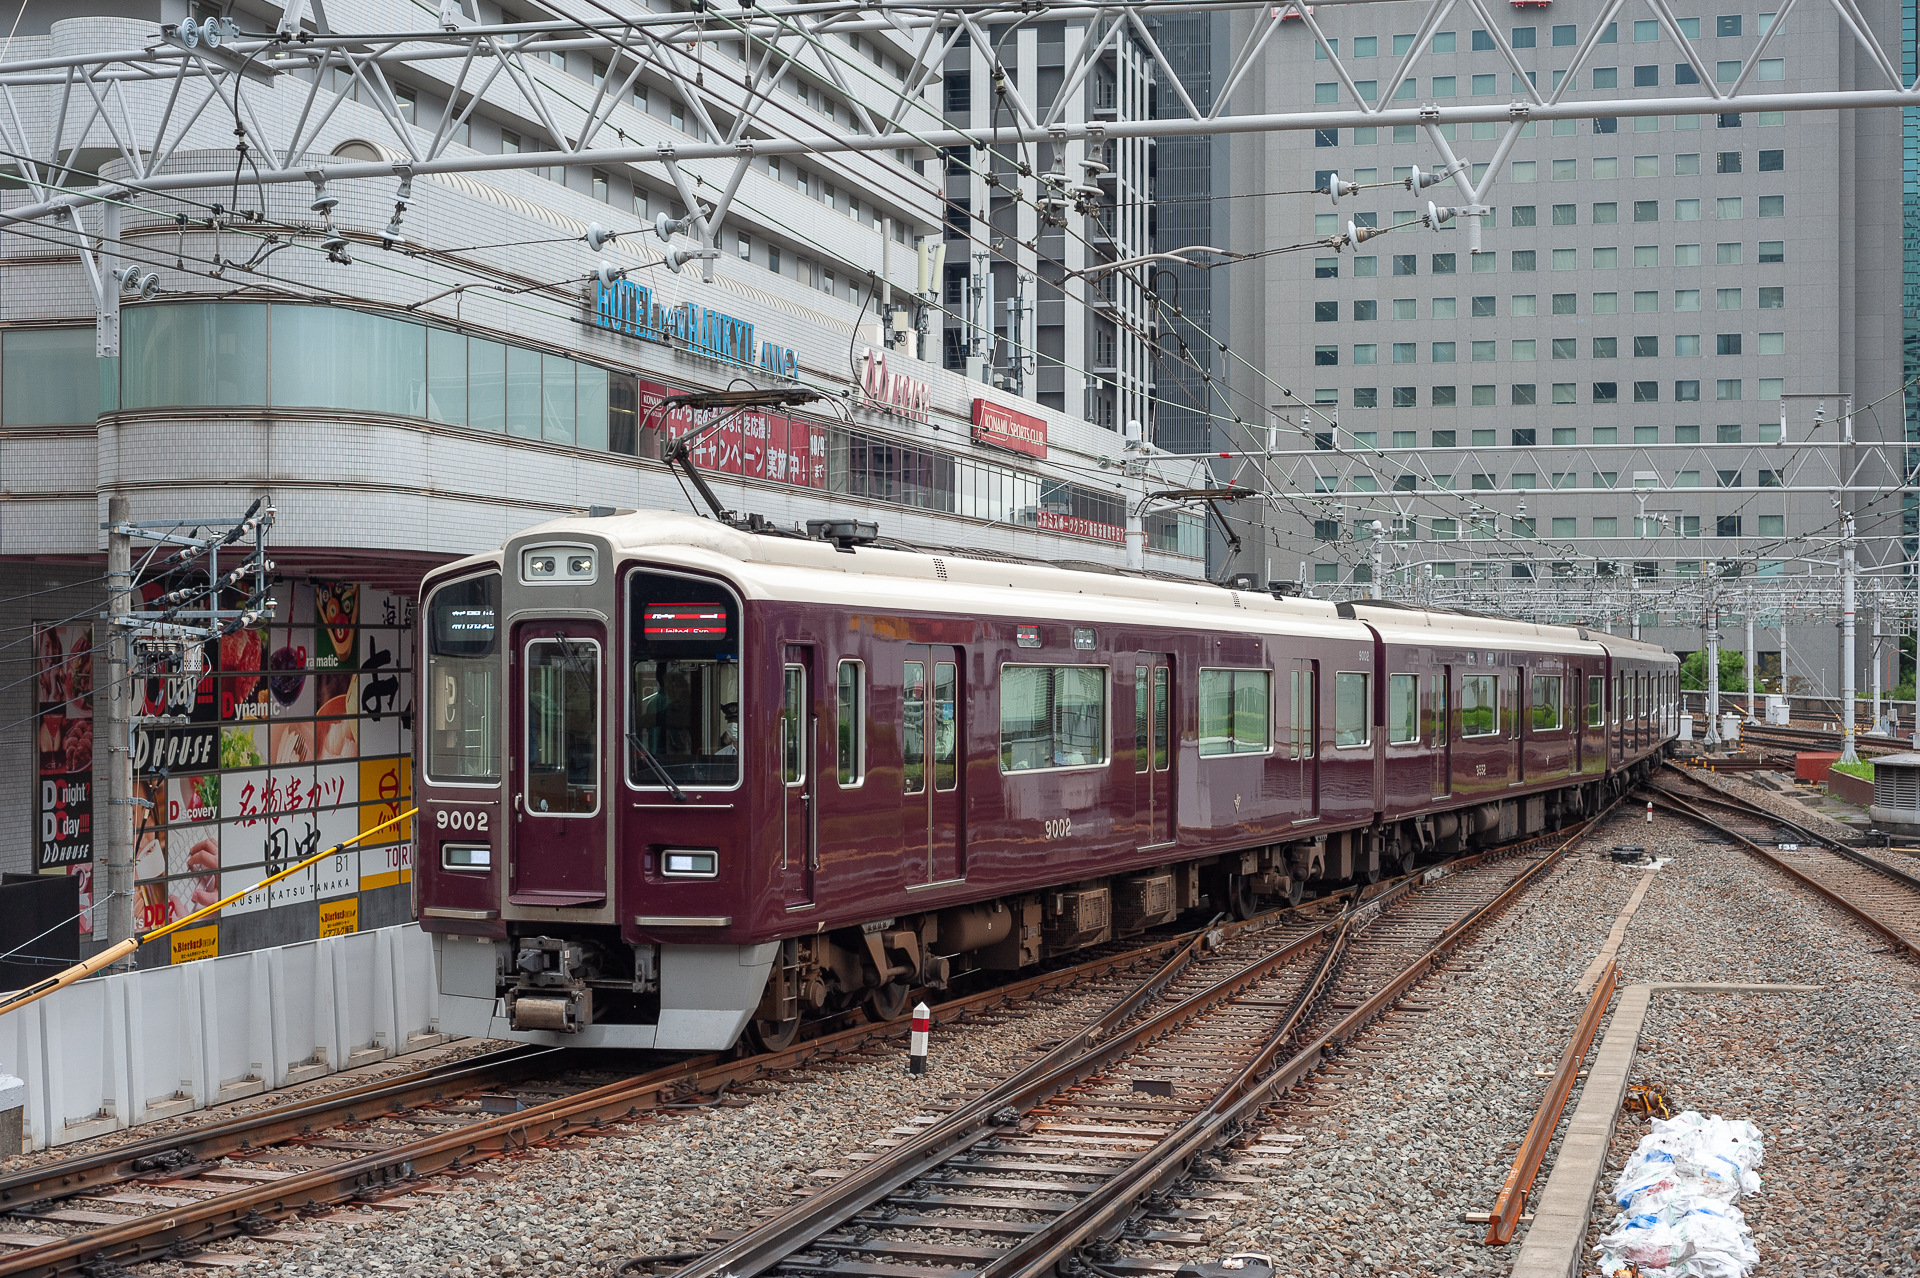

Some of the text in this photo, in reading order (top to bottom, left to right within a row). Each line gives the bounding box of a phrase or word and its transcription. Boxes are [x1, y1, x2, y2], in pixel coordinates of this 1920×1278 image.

[597, 279, 657, 341] HOTEL
[687, 302, 755, 371] HANKYU
[760, 341, 799, 385] ANNEX
[984, 413, 1044, 446] KONAMI SPORTS CLUB
[297, 645, 338, 668] Dramatic
[222, 692, 281, 721] Dynamic
[169, 800, 218, 821] Discovery
[234, 775, 345, 828] 名物串カツ
[436, 810, 489, 831] 9002
[1045, 818, 1072, 840] 9002
[335, 855, 349, 873] B1
[310, 878, 350, 893] TANAKA
